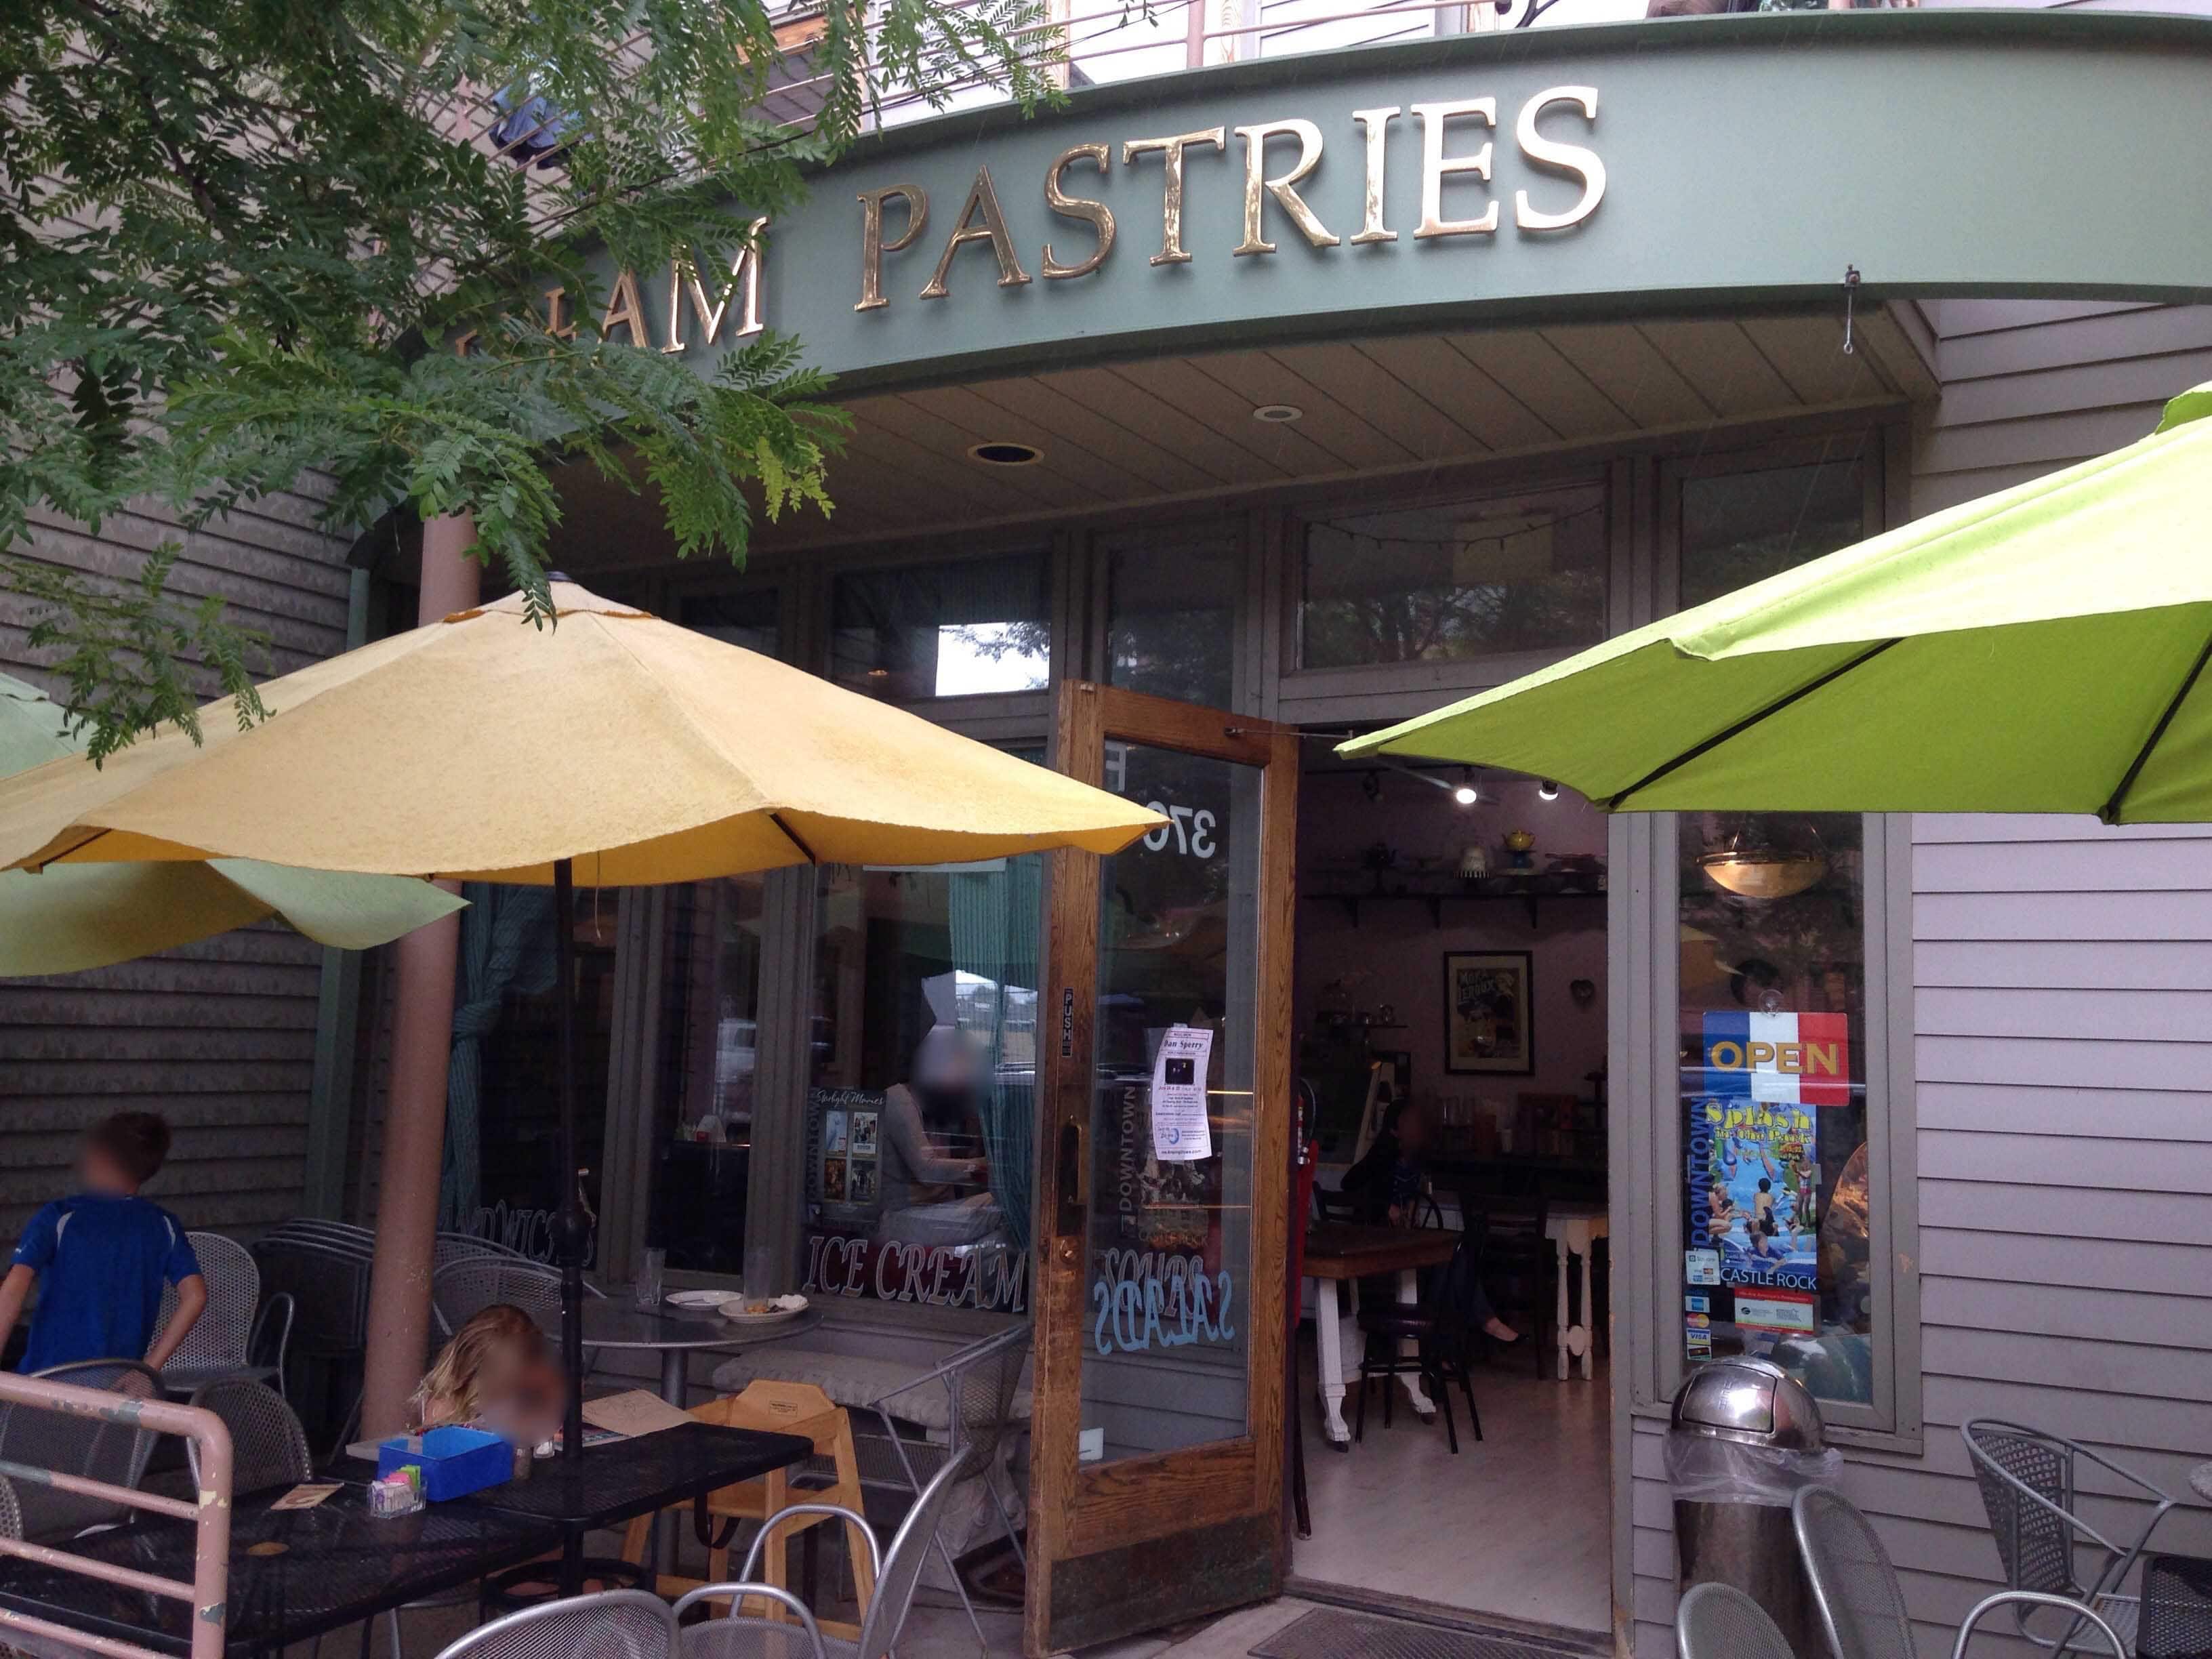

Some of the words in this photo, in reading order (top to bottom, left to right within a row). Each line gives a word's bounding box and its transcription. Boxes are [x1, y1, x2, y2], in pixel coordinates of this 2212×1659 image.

[854, 85, 1607, 312] PASTRIES
[1711, 1041, 1839, 1075] OPEN
[1705, 1103, 1811, 1130] Splash
[1119, 1086, 1136, 1211] DOWNTOWN
[1690, 1097, 1710, 1246] DOWNTOWN
[802, 1235, 868, 1298] ICE
[875, 1240, 1029, 1313] CREAM
[1720, 1267, 1774, 1286] CASTLE
[1776, 1273, 1818, 1291] ROCK
[1690, 1332, 1708, 1340] VISA
